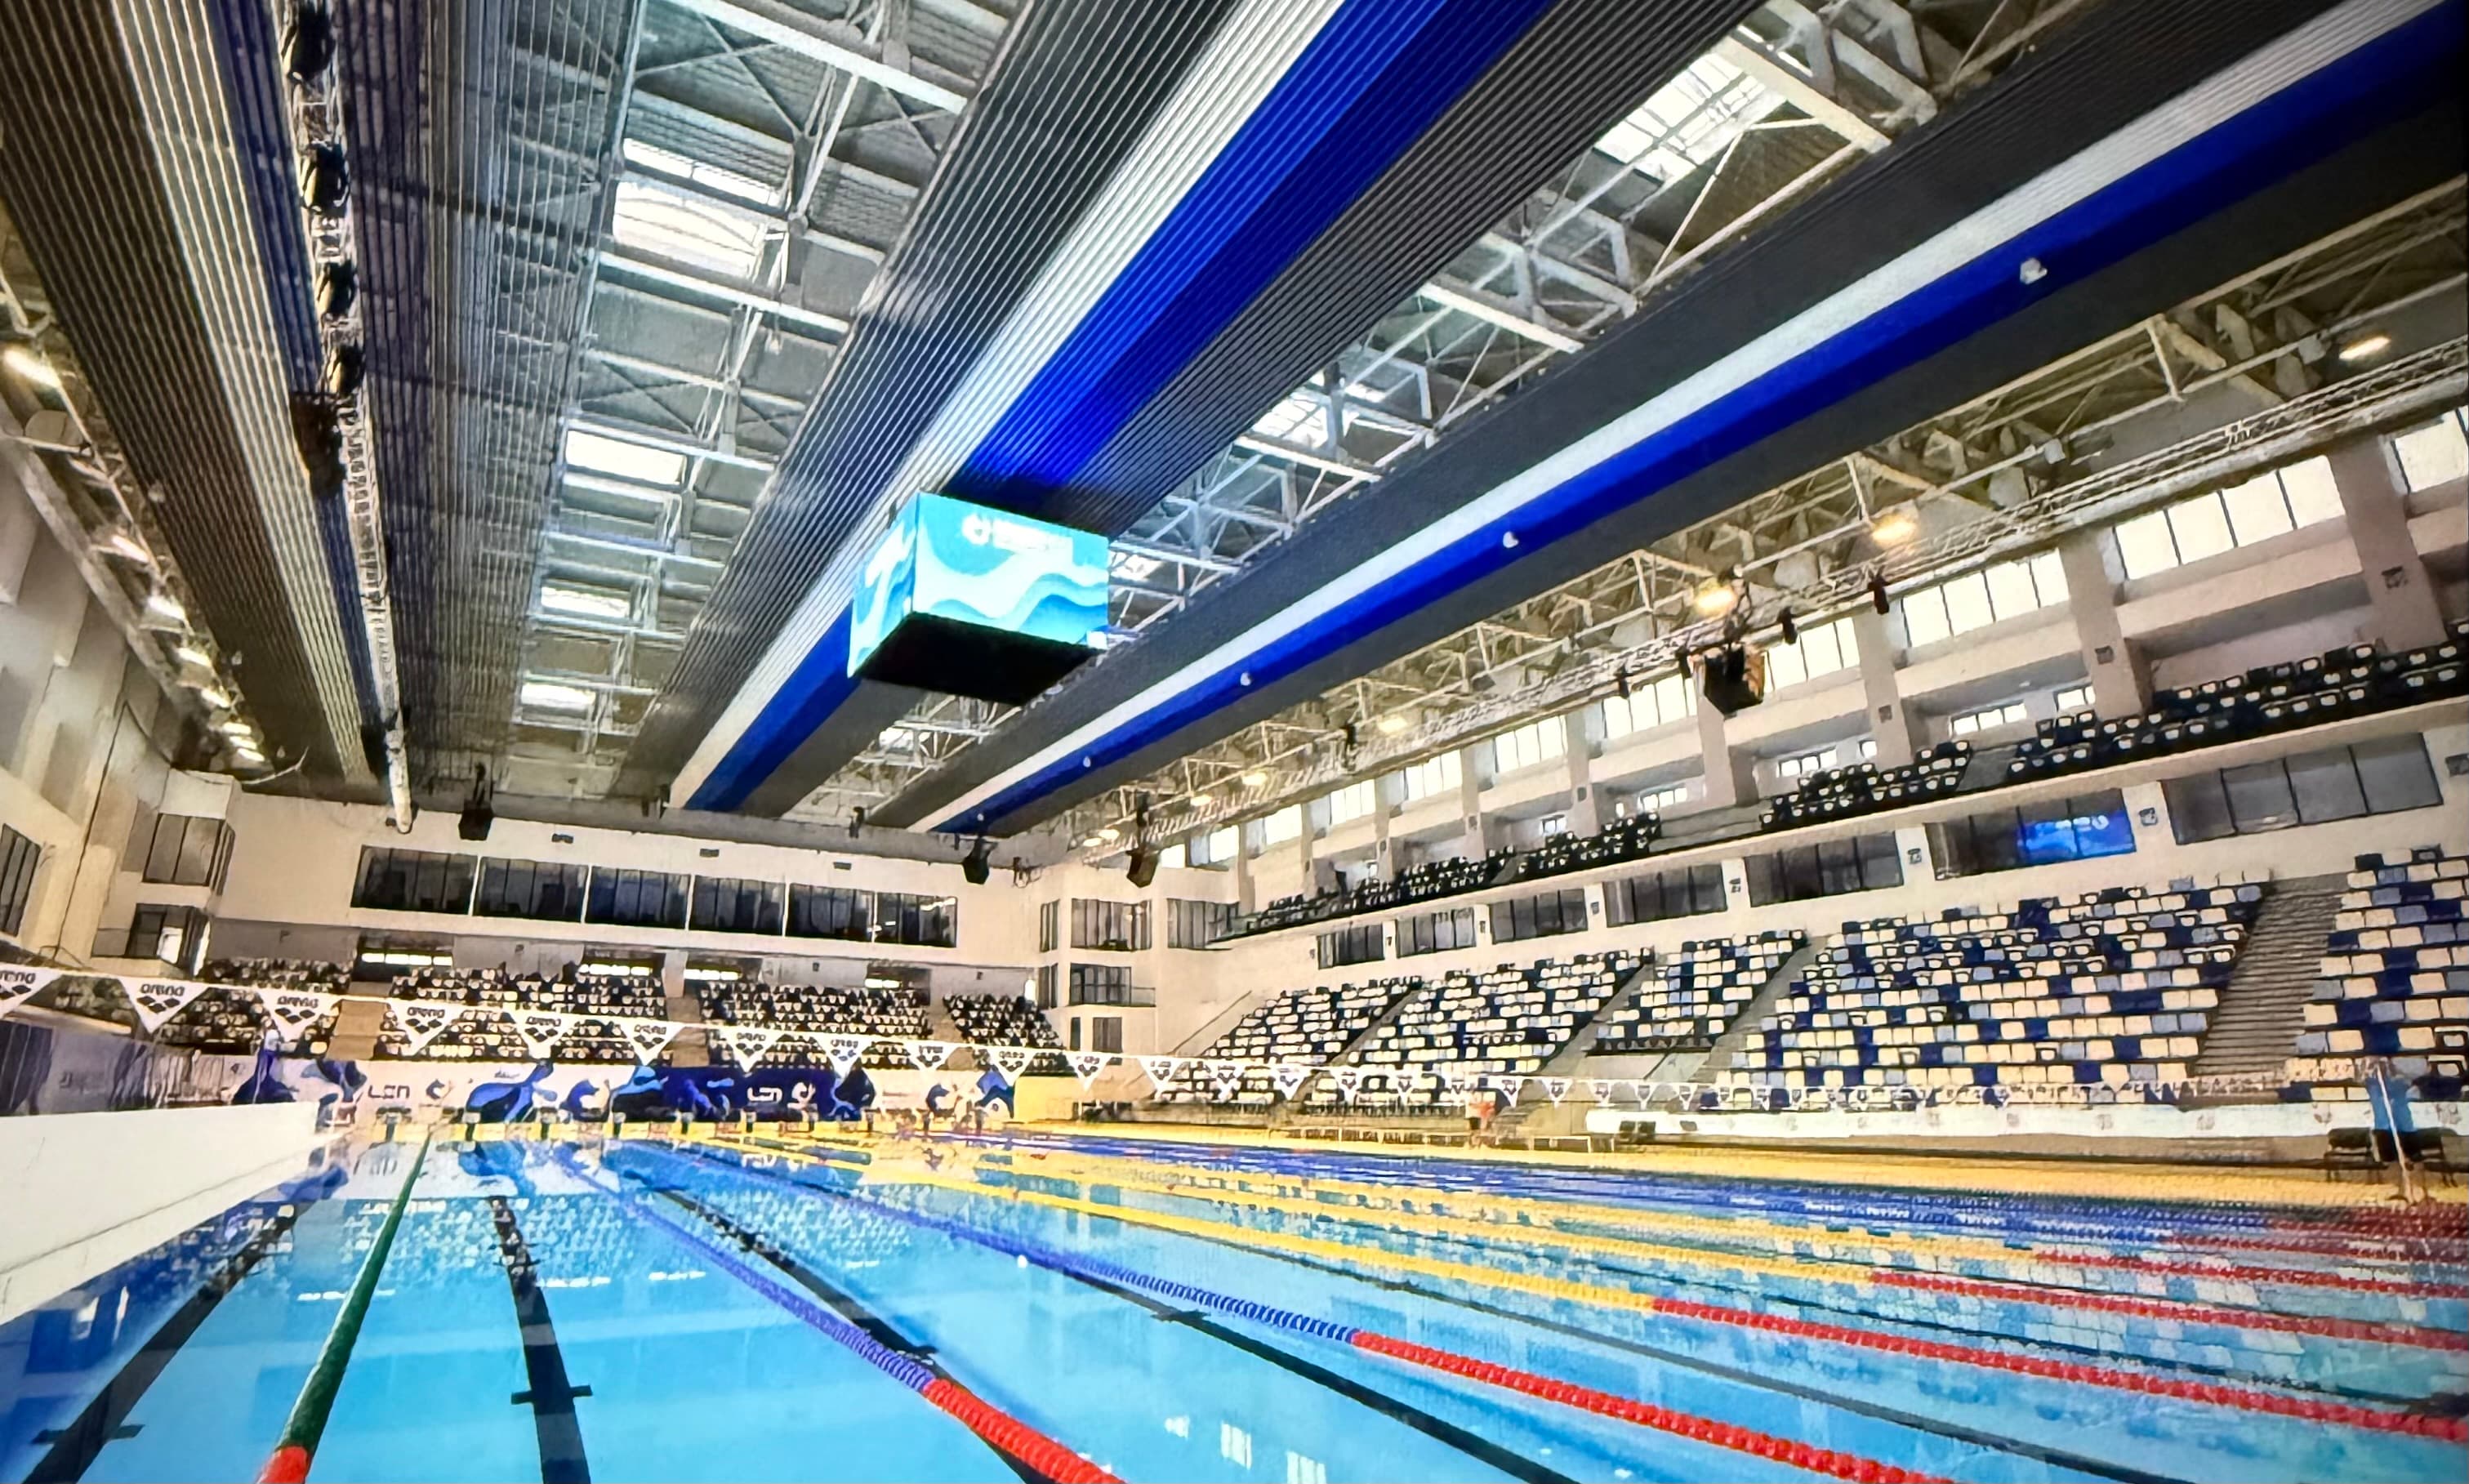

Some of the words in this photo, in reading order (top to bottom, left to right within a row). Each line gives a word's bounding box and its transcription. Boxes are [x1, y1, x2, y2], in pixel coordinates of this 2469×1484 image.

[0, 969, 36, 984] rena
[140, 983, 185, 996] arena
[277, 996, 319, 1008] arena
